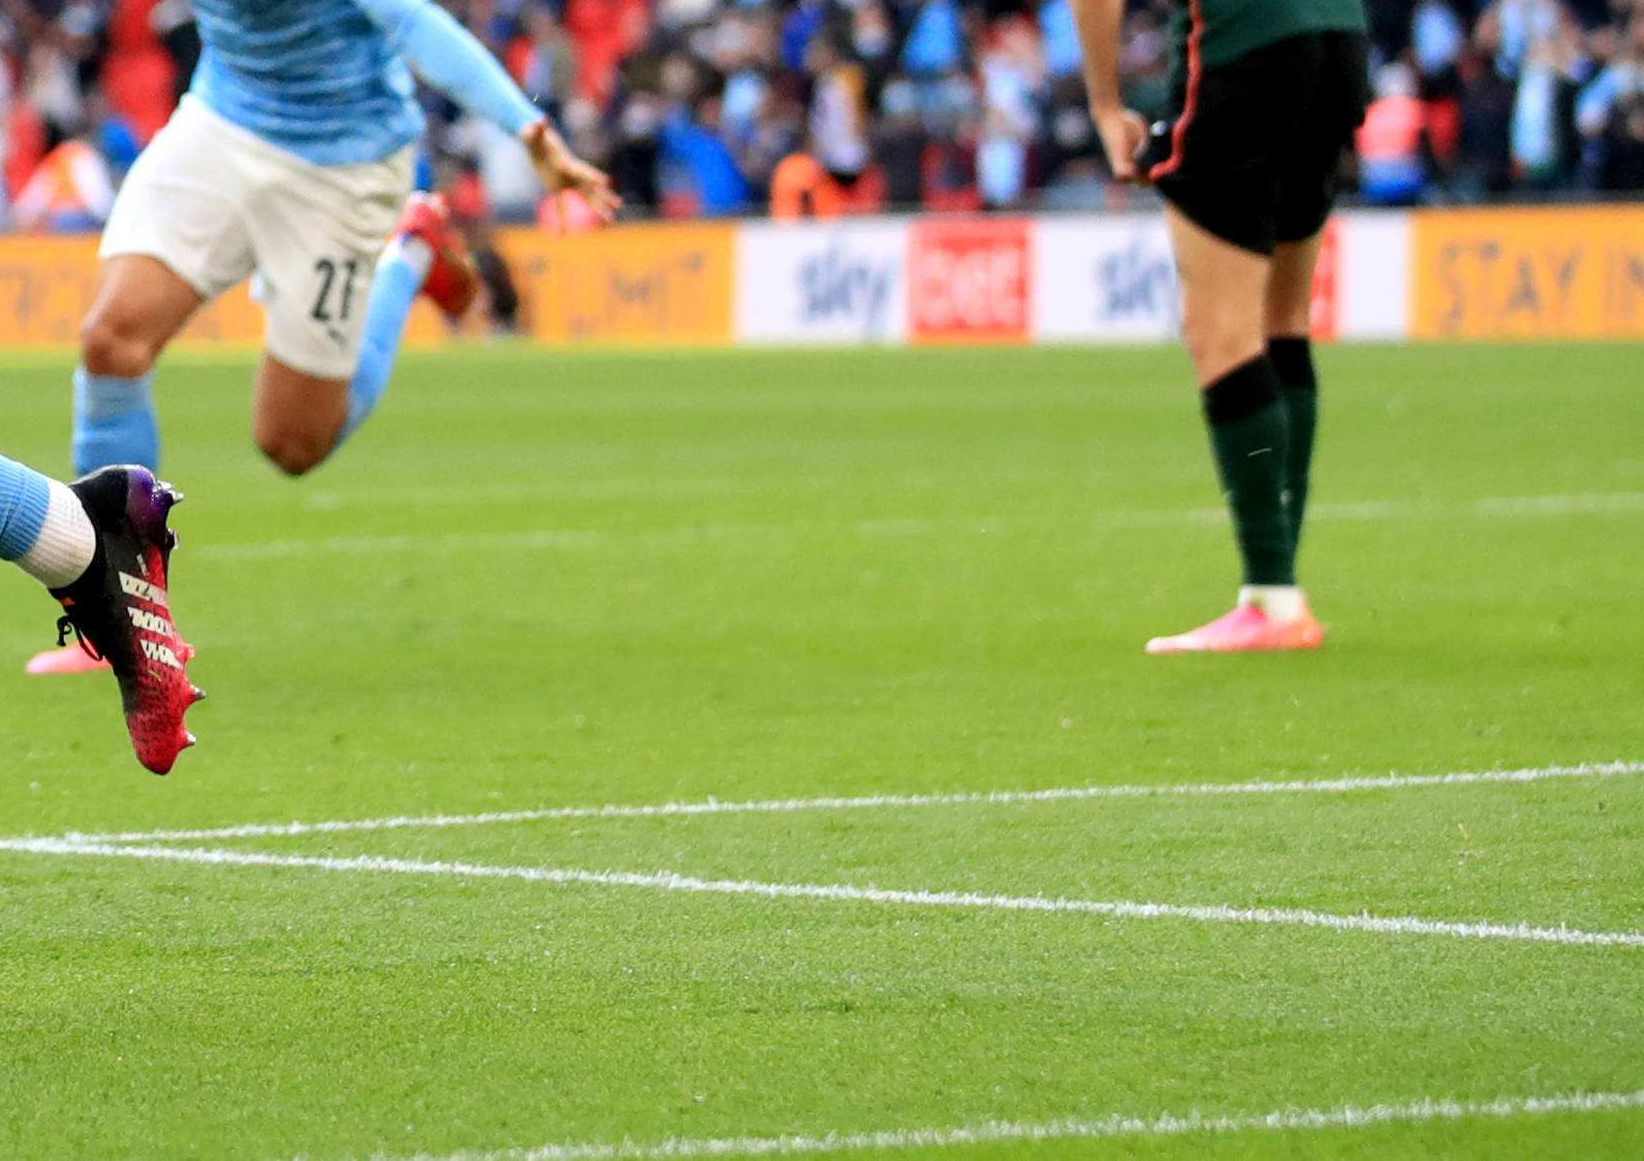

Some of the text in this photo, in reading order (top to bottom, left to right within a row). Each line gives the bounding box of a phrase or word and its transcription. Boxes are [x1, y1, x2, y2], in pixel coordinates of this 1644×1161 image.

[311, 257, 357, 322] 21
[796, 230, 1026, 338] sky bet
[1436, 238, 1583, 332] STAY
